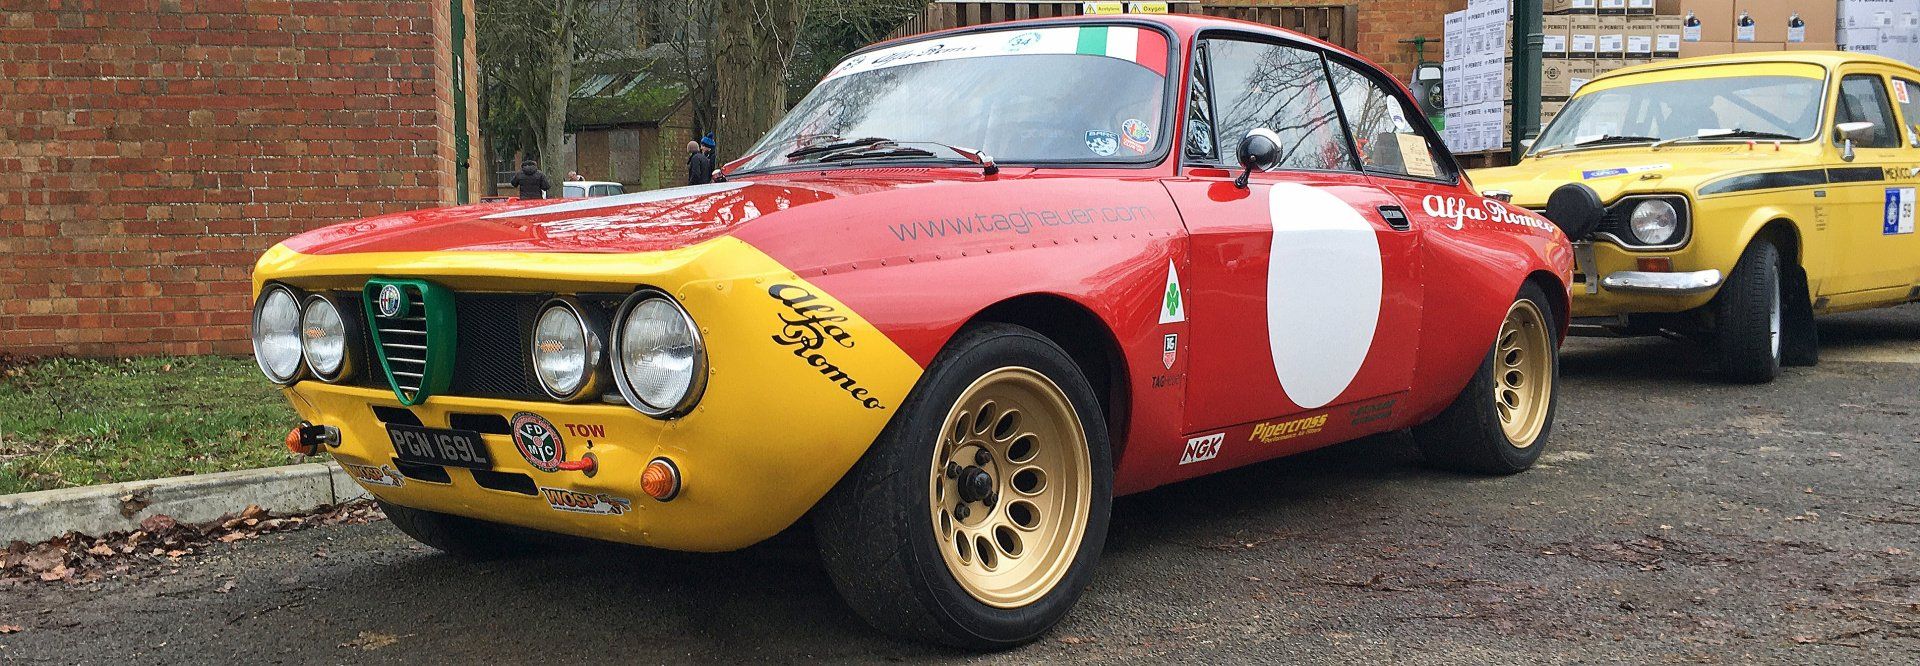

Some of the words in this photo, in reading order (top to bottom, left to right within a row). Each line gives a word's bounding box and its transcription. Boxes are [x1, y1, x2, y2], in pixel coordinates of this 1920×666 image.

[1449, 16, 1463, 25] PENRITE
[1471, 12, 1485, 20] PENRITE
[1447, 65, 1461, 73] PENRITE
[1468, 61, 1482, 69] PENRITE
[1488, 57, 1503, 65] PENRITE
[1467, 108, 1481, 116] PENRITE
[1422, 195, 1488, 230] Alfa
[1483, 200, 1555, 233] Romeo
[888, 205, 1156, 241] www.tagheuer.com
[768, 284, 855, 348] Alfa
[772, 321, 886, 409] Romeo
[525, 424, 543, 435] FD
[565, 424, 605, 438] TOW
[1249, 414, 1328, 443] Pipercross
[391, 429, 436, 458] PGN
[434, 433, 487, 464] 169L
[1182, 437, 1222, 461] NGK
[350, 465, 384, 481] WOSP
[540, 487, 599, 508] WOSP
